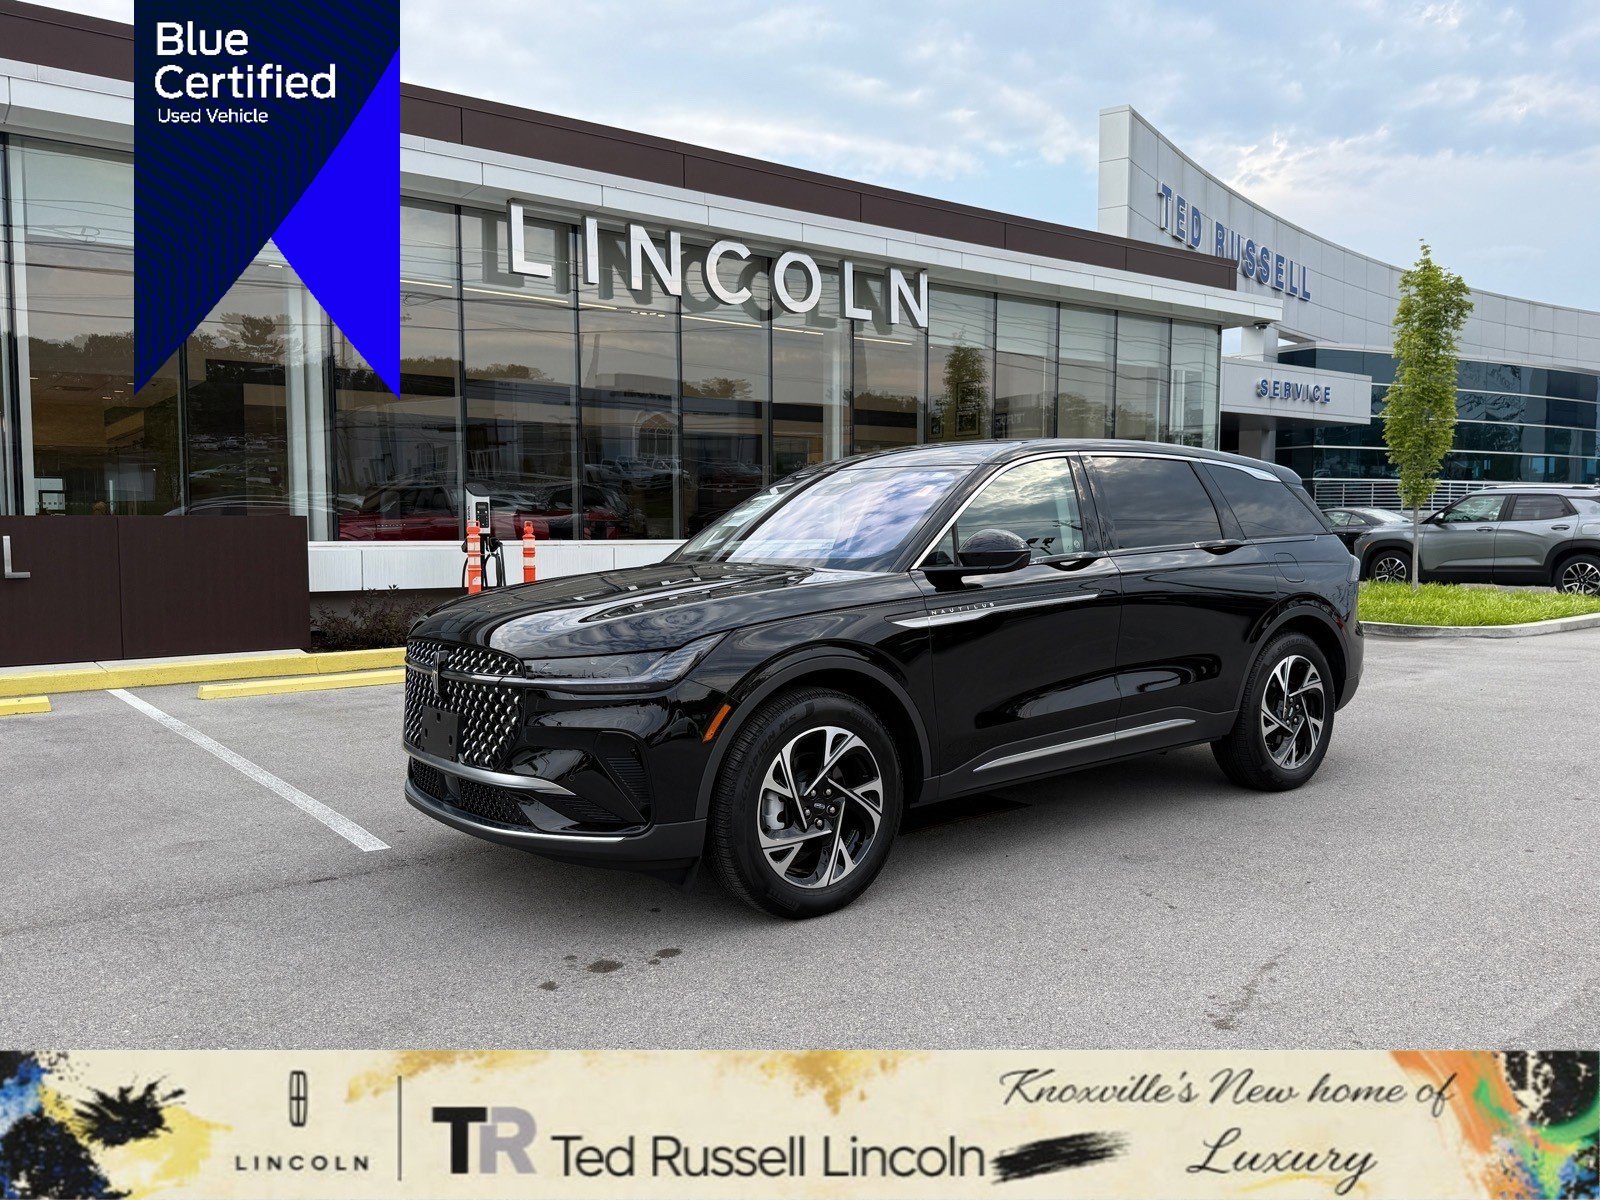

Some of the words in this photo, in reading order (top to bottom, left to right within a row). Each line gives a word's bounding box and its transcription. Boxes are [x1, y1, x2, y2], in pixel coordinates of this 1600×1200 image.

[507, 199, 928, 328] LINCOLN
[1158, 182, 1202, 250] TED
[1213, 219, 1311, 301] RUSSELL
[1257, 379, 1331, 404] SERVICE
[931, 602, 995, 616] NAUTILUS
